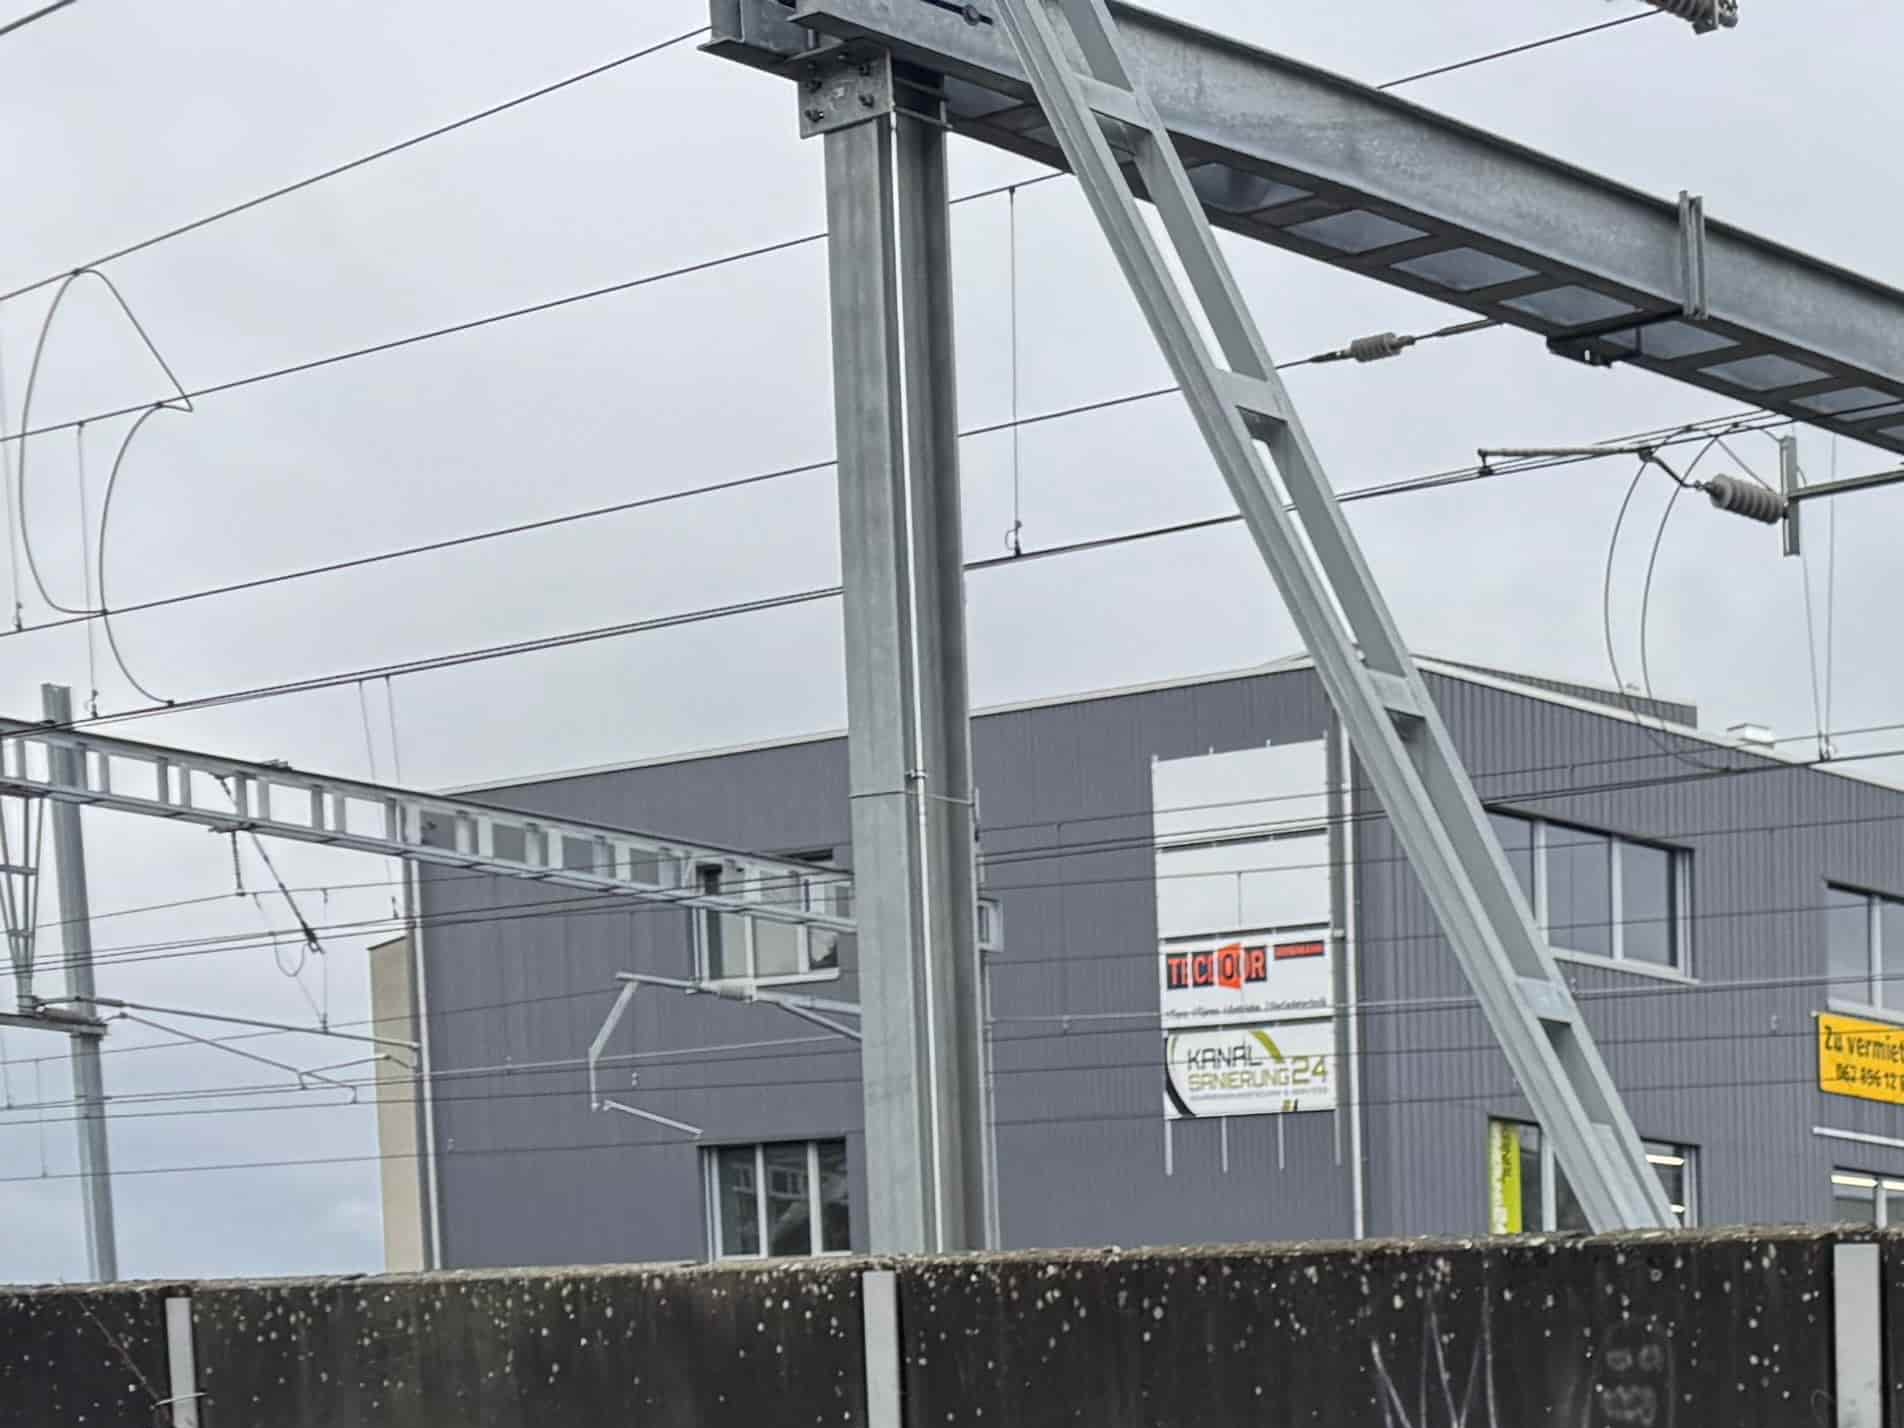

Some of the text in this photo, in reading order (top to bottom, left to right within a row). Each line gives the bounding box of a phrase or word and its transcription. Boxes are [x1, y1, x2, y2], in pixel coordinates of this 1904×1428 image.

[1824, 1024, 1843, 1053] Zu
[1187, 1044, 1263, 1070] KANAL
[1187, 1055, 1329, 1092] SANIERUNG 24
